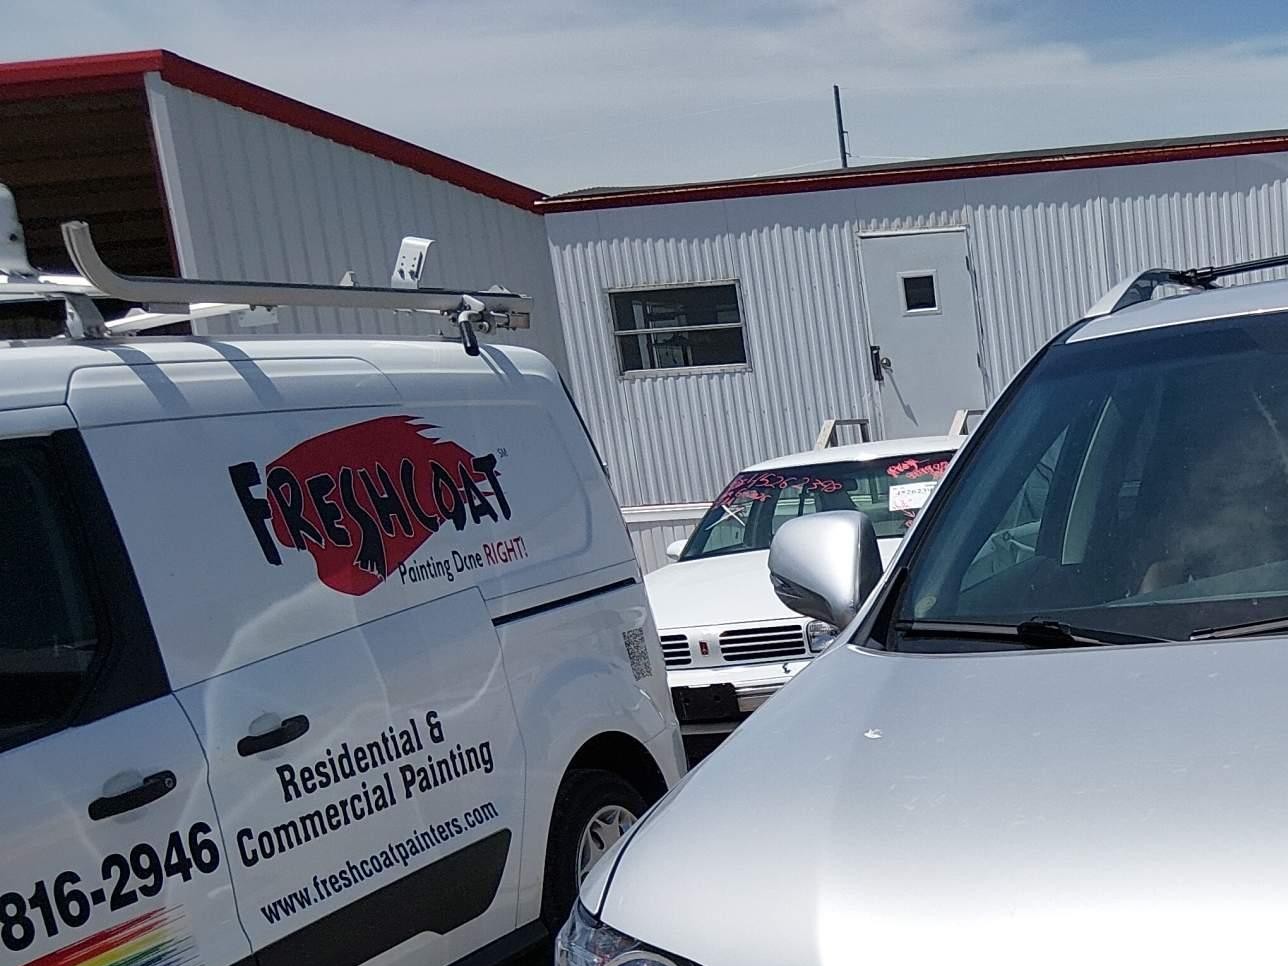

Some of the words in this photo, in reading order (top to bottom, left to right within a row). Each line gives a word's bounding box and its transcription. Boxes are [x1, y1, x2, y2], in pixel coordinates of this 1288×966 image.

[398, 559, 452, 585] Painting
[484, 536, 528, 566] RIGHT!
[236, 773, 397, 868] Commercial
[399, 740, 495, 799] Painting
[276, 718, 424, 803] Residential
[426, 711, 445, 744] &
[0, 821, 220, 951] 816-2946
[260, 800, 499, 925] www.freshcoatpainters.com
